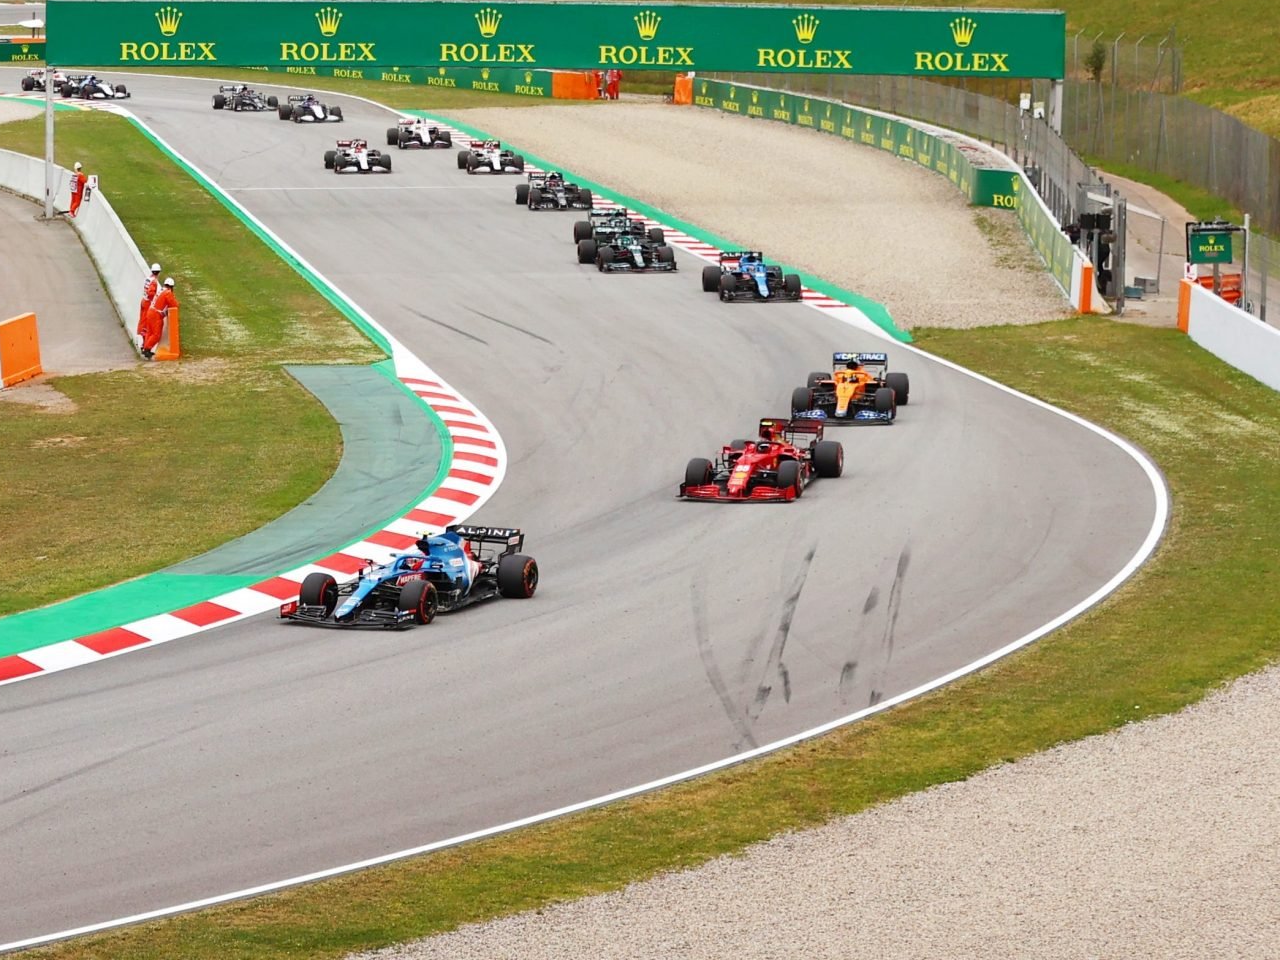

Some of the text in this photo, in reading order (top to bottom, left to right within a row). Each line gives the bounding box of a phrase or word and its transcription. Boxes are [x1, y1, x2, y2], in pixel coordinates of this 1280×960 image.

[119, 42, 1009, 72] ROLEX ROLEX ROLEX ROLEX ROLEX ROLEX
[333, 68, 364, 78] ROLEX
[382, 72, 412, 83] ROLEX
[428, 76, 456, 88] ROLEX
[472, 80, 500, 92] ROLEX
[515, 84, 544, 96] ROLEX
[1199, 244, 1224, 252] ROLEX
